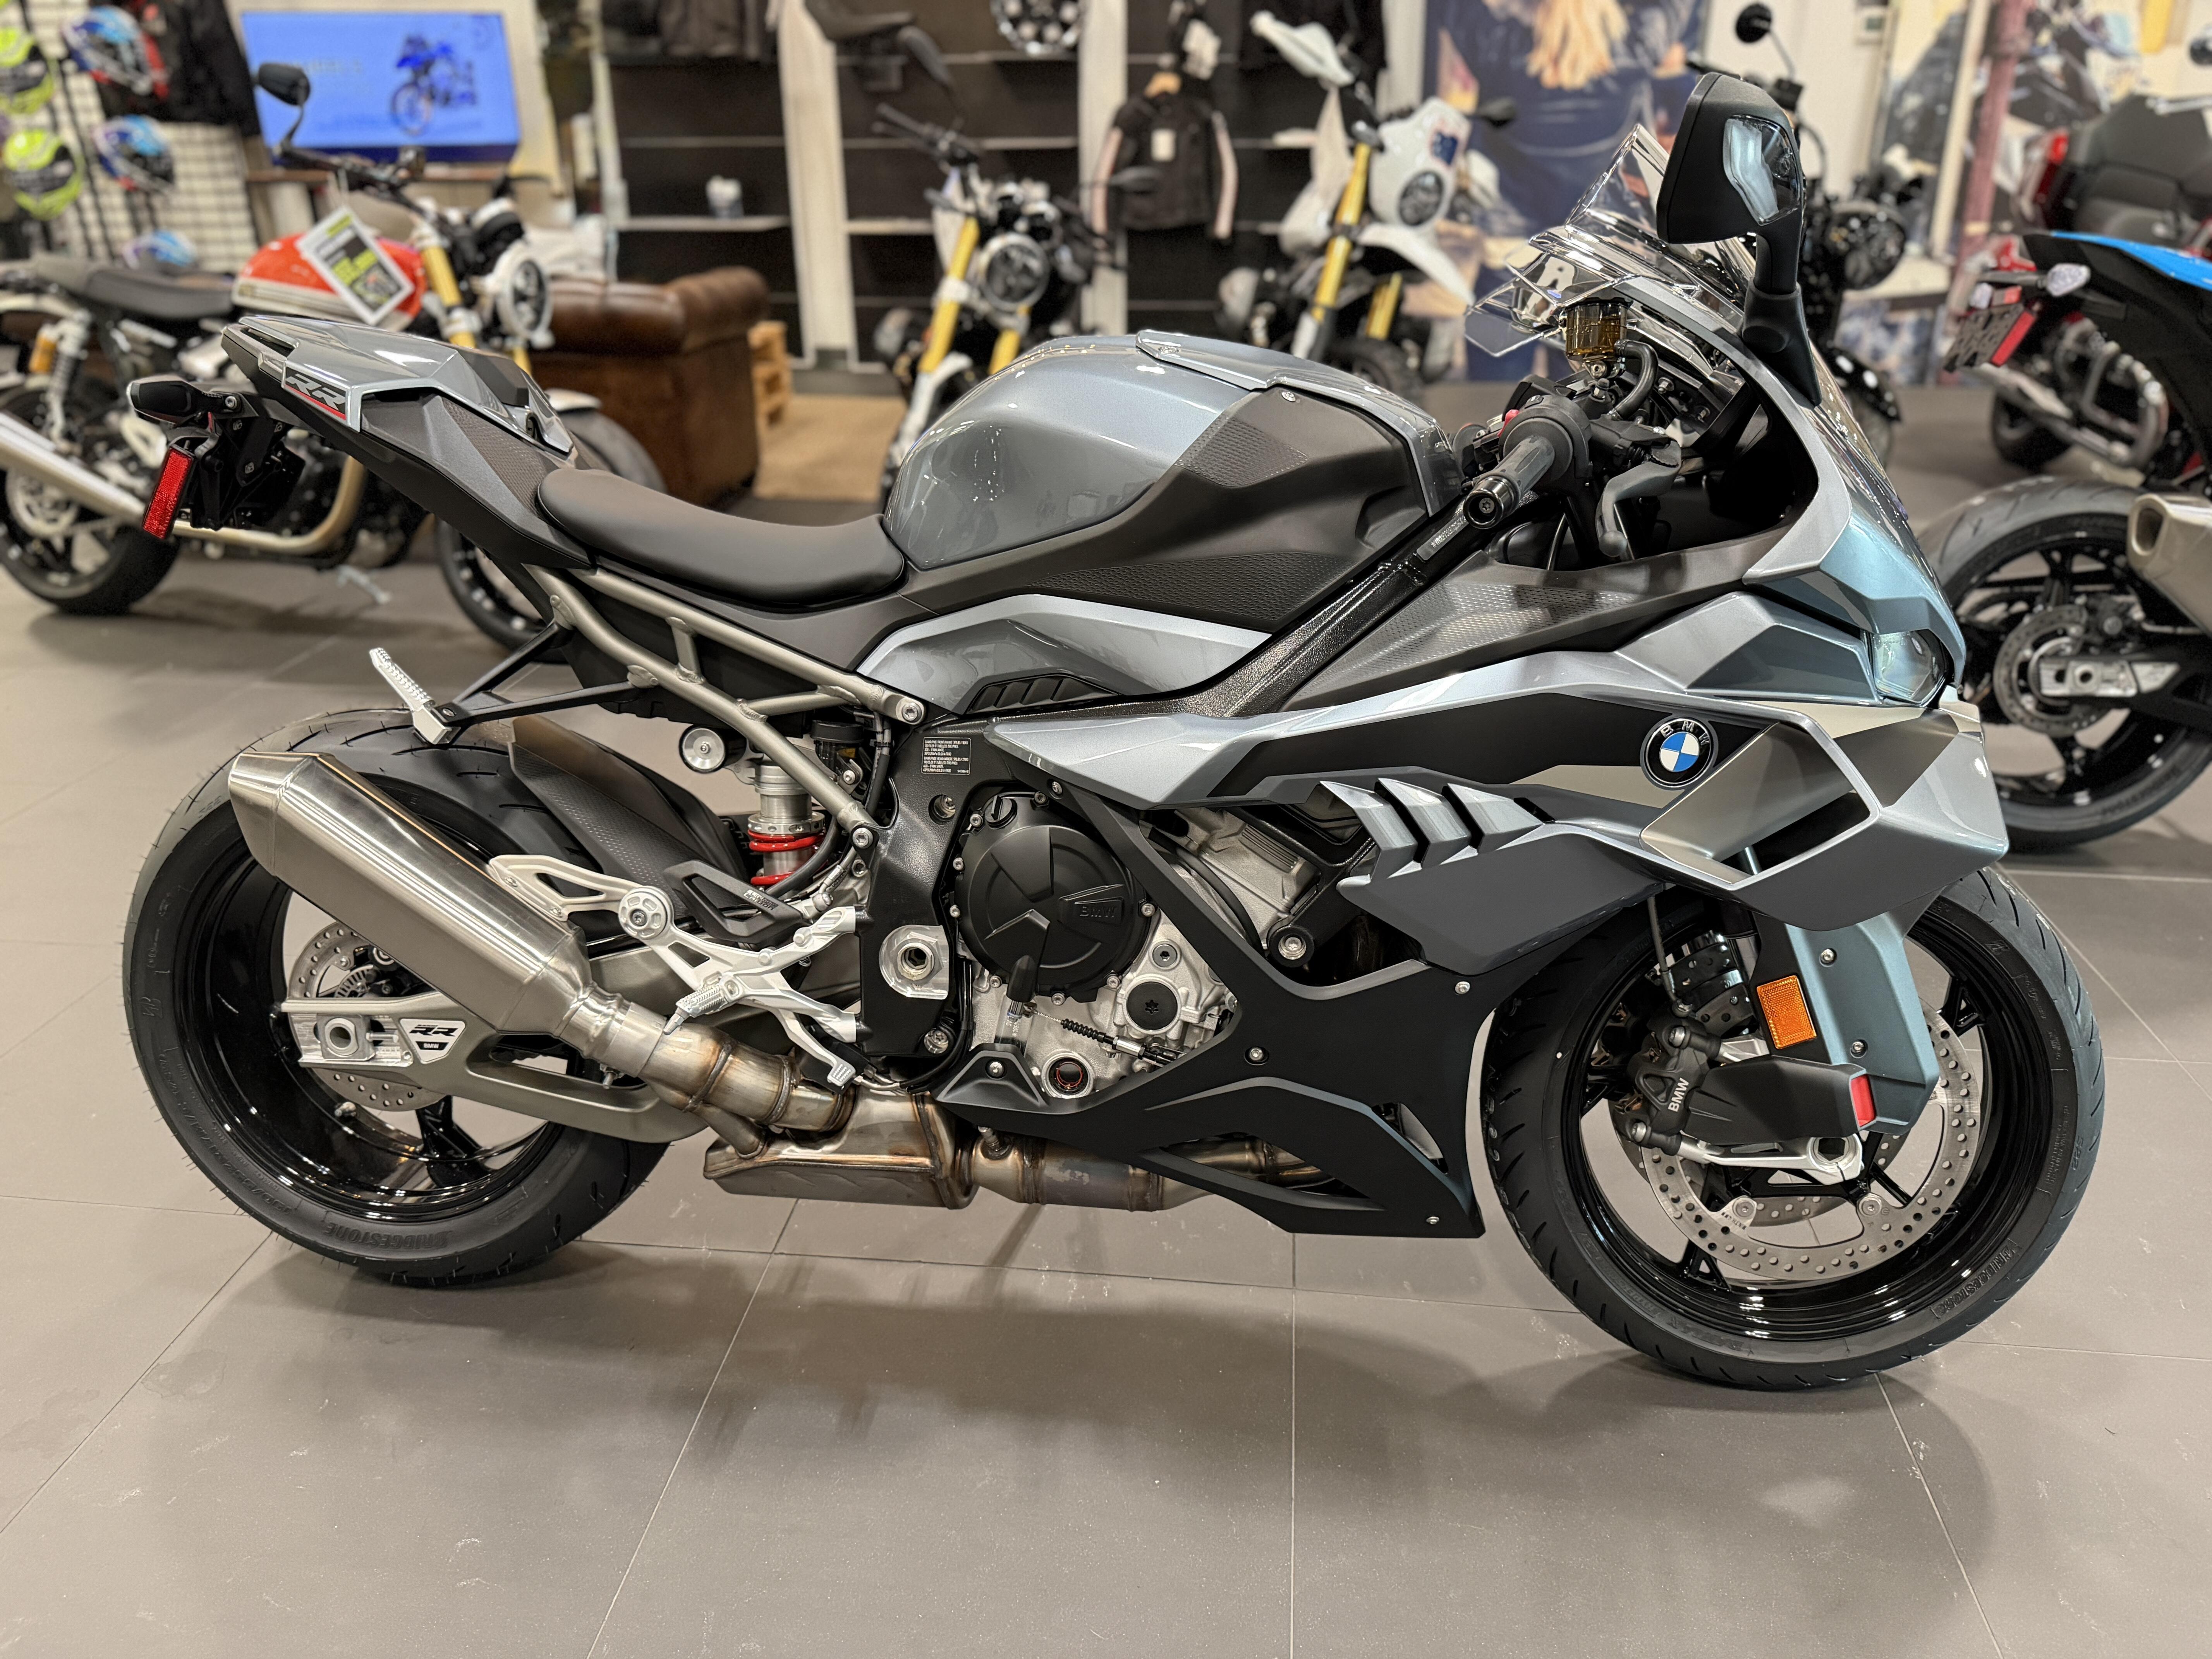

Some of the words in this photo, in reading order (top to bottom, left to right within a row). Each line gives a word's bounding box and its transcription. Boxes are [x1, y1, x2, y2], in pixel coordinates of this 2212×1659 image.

[285, 373, 346, 410] RR
[1660, 721, 1710, 746] BMW
[1080, 907, 1116, 918] BMW
[409, 1027, 458, 1037] RR
[1668, 1078, 1689, 1112] BMW
[323, 1222, 452, 1249] BRIDGESTONE
